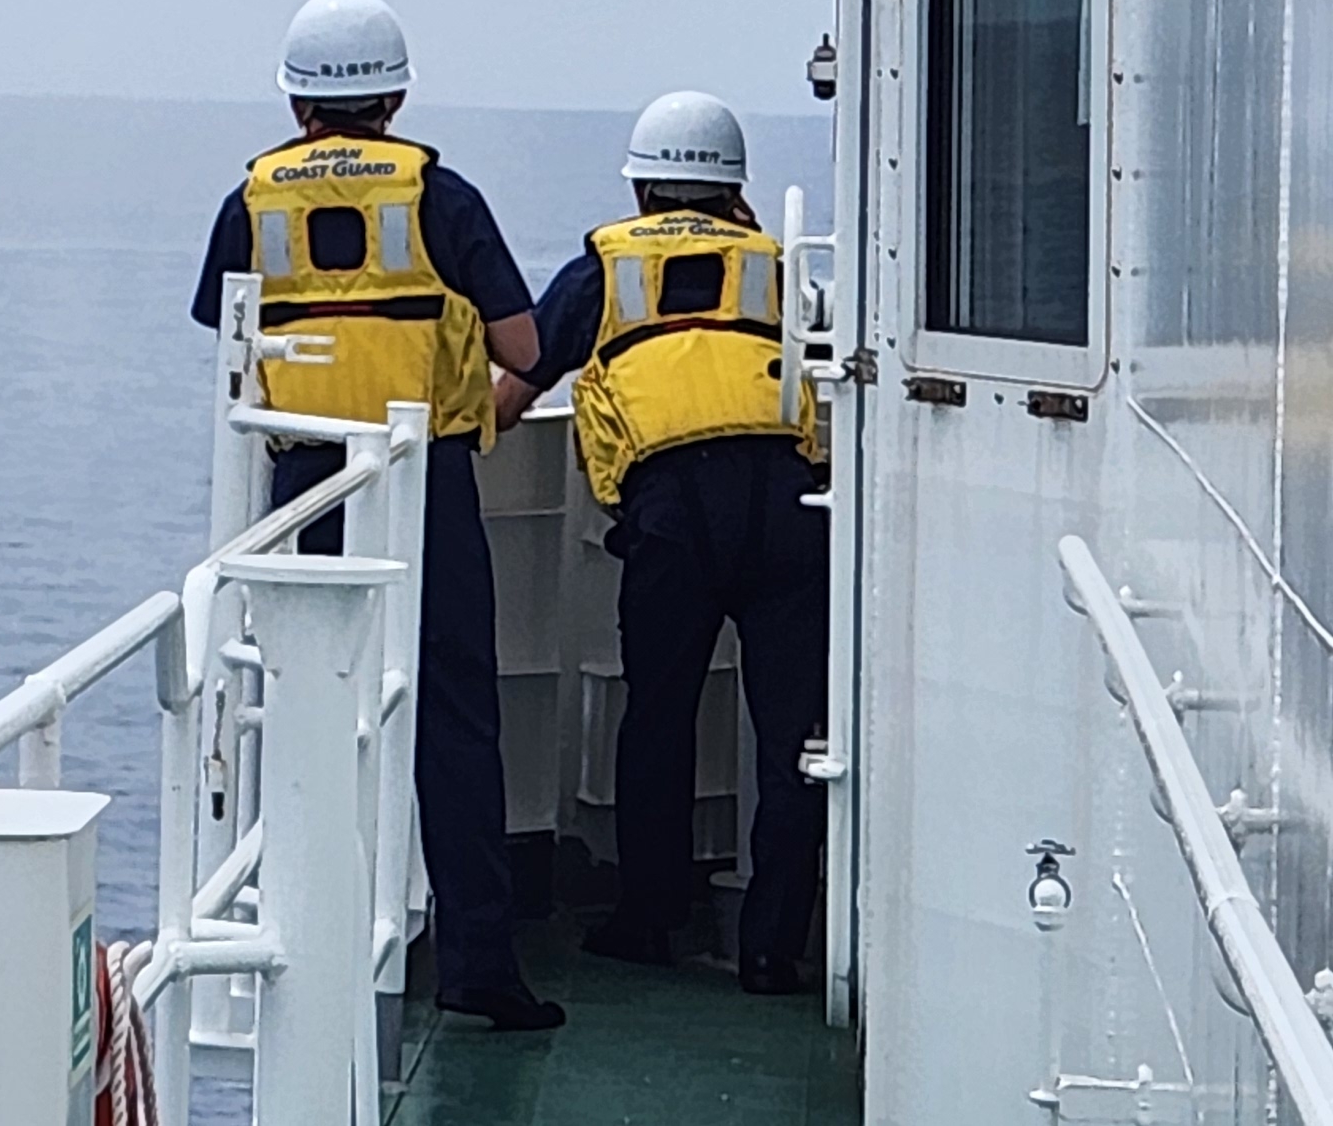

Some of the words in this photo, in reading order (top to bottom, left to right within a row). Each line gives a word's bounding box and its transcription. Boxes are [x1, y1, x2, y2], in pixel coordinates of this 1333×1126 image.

[301, 147, 363, 162] JAPAN
[271, 164, 330, 183] COAST
[331, 160, 397, 177] GUARD
[628, 226, 686, 237] COAST
